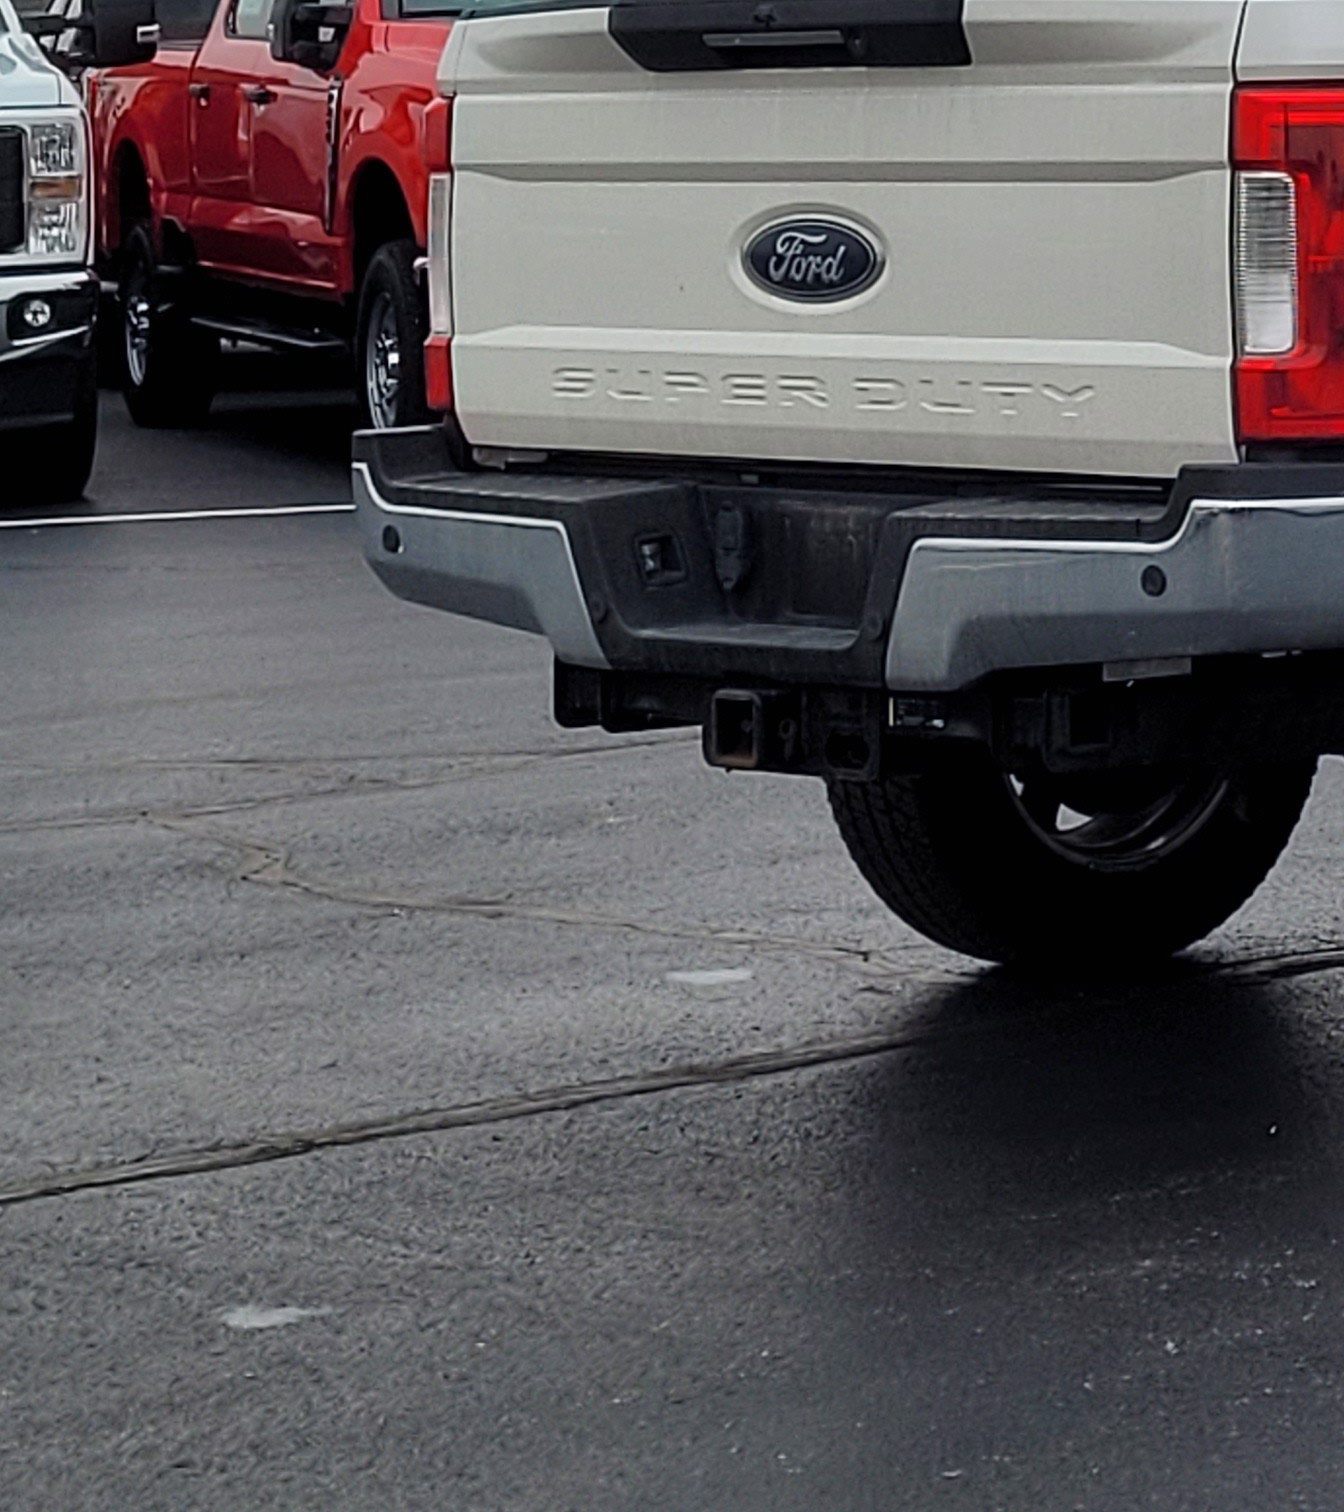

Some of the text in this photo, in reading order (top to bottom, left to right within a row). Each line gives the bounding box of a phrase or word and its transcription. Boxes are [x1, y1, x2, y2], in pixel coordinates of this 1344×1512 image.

[769, 231, 846, 284] Ford
[552, 367, 1096, 417] SUPER DUTY
